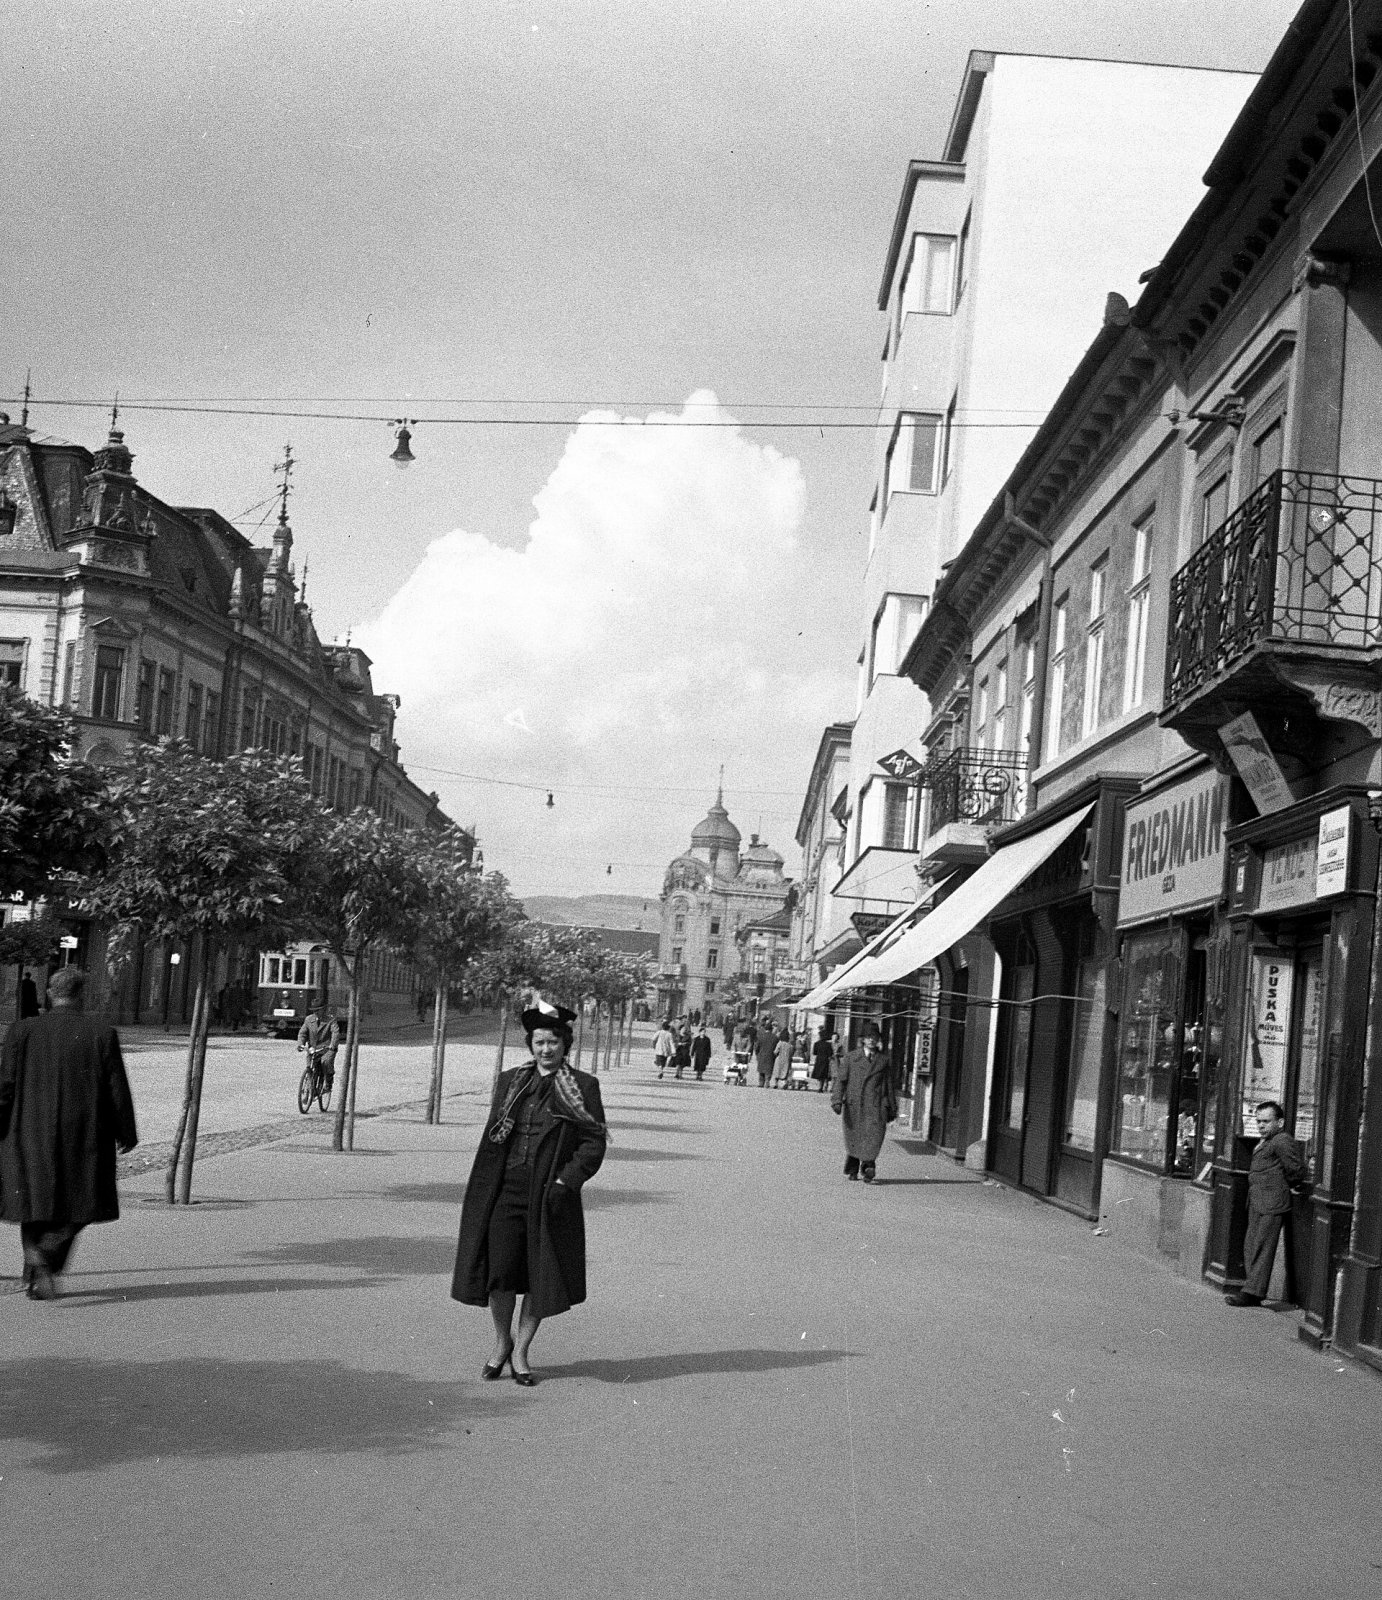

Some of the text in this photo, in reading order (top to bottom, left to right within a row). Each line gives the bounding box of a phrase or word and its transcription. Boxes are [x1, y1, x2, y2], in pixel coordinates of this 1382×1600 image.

[884, 754, 912, 775] Agfa
[1126, 783, 1224, 885] FRIEDMANN
[1265, 965, 1279, 1021] PUSKA
[922, 1033, 930, 1068] KODAK
